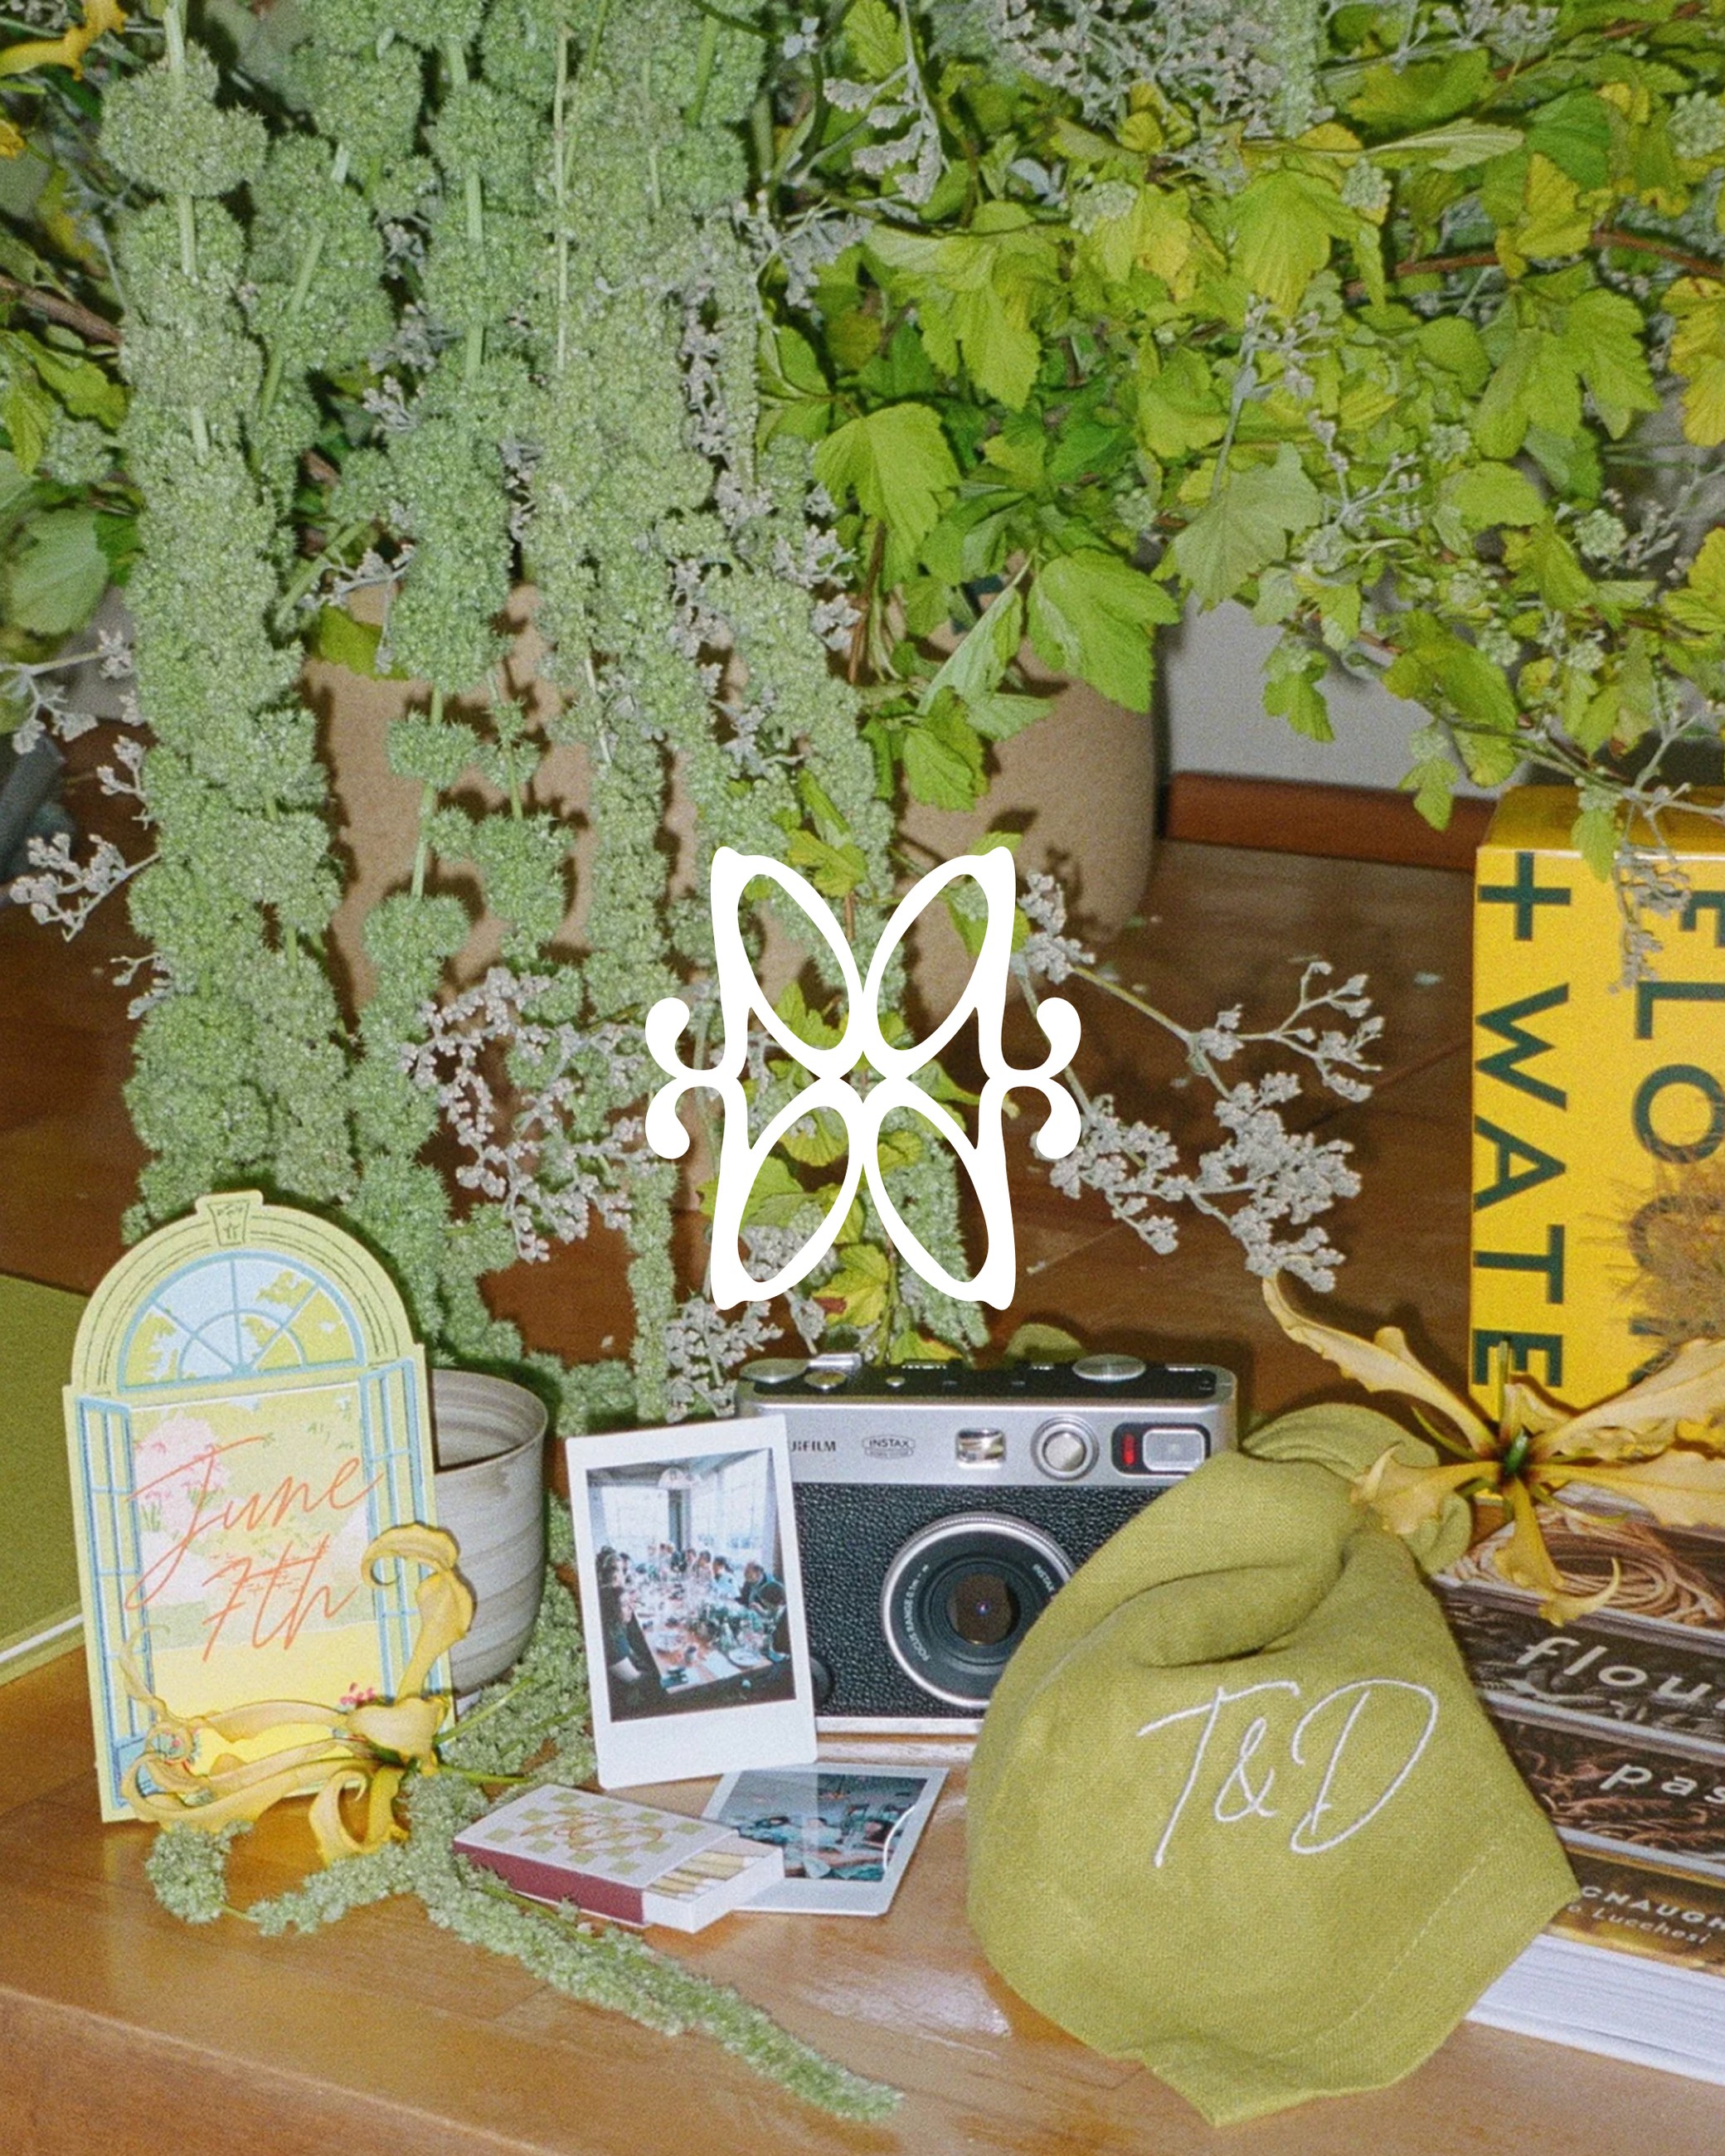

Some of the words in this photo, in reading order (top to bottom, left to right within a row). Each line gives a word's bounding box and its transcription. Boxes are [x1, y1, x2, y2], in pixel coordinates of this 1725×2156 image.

[1471, 982, 1569, 1387] WATE
[869, 1439, 909, 1448] INSTAX
[124, 1435, 385, 1611] June
[202, 1533, 358, 1663] 7th
[1133, 1678, 1439, 1868] T&D
[1591, 1907, 1712, 1945] Lucchesi
